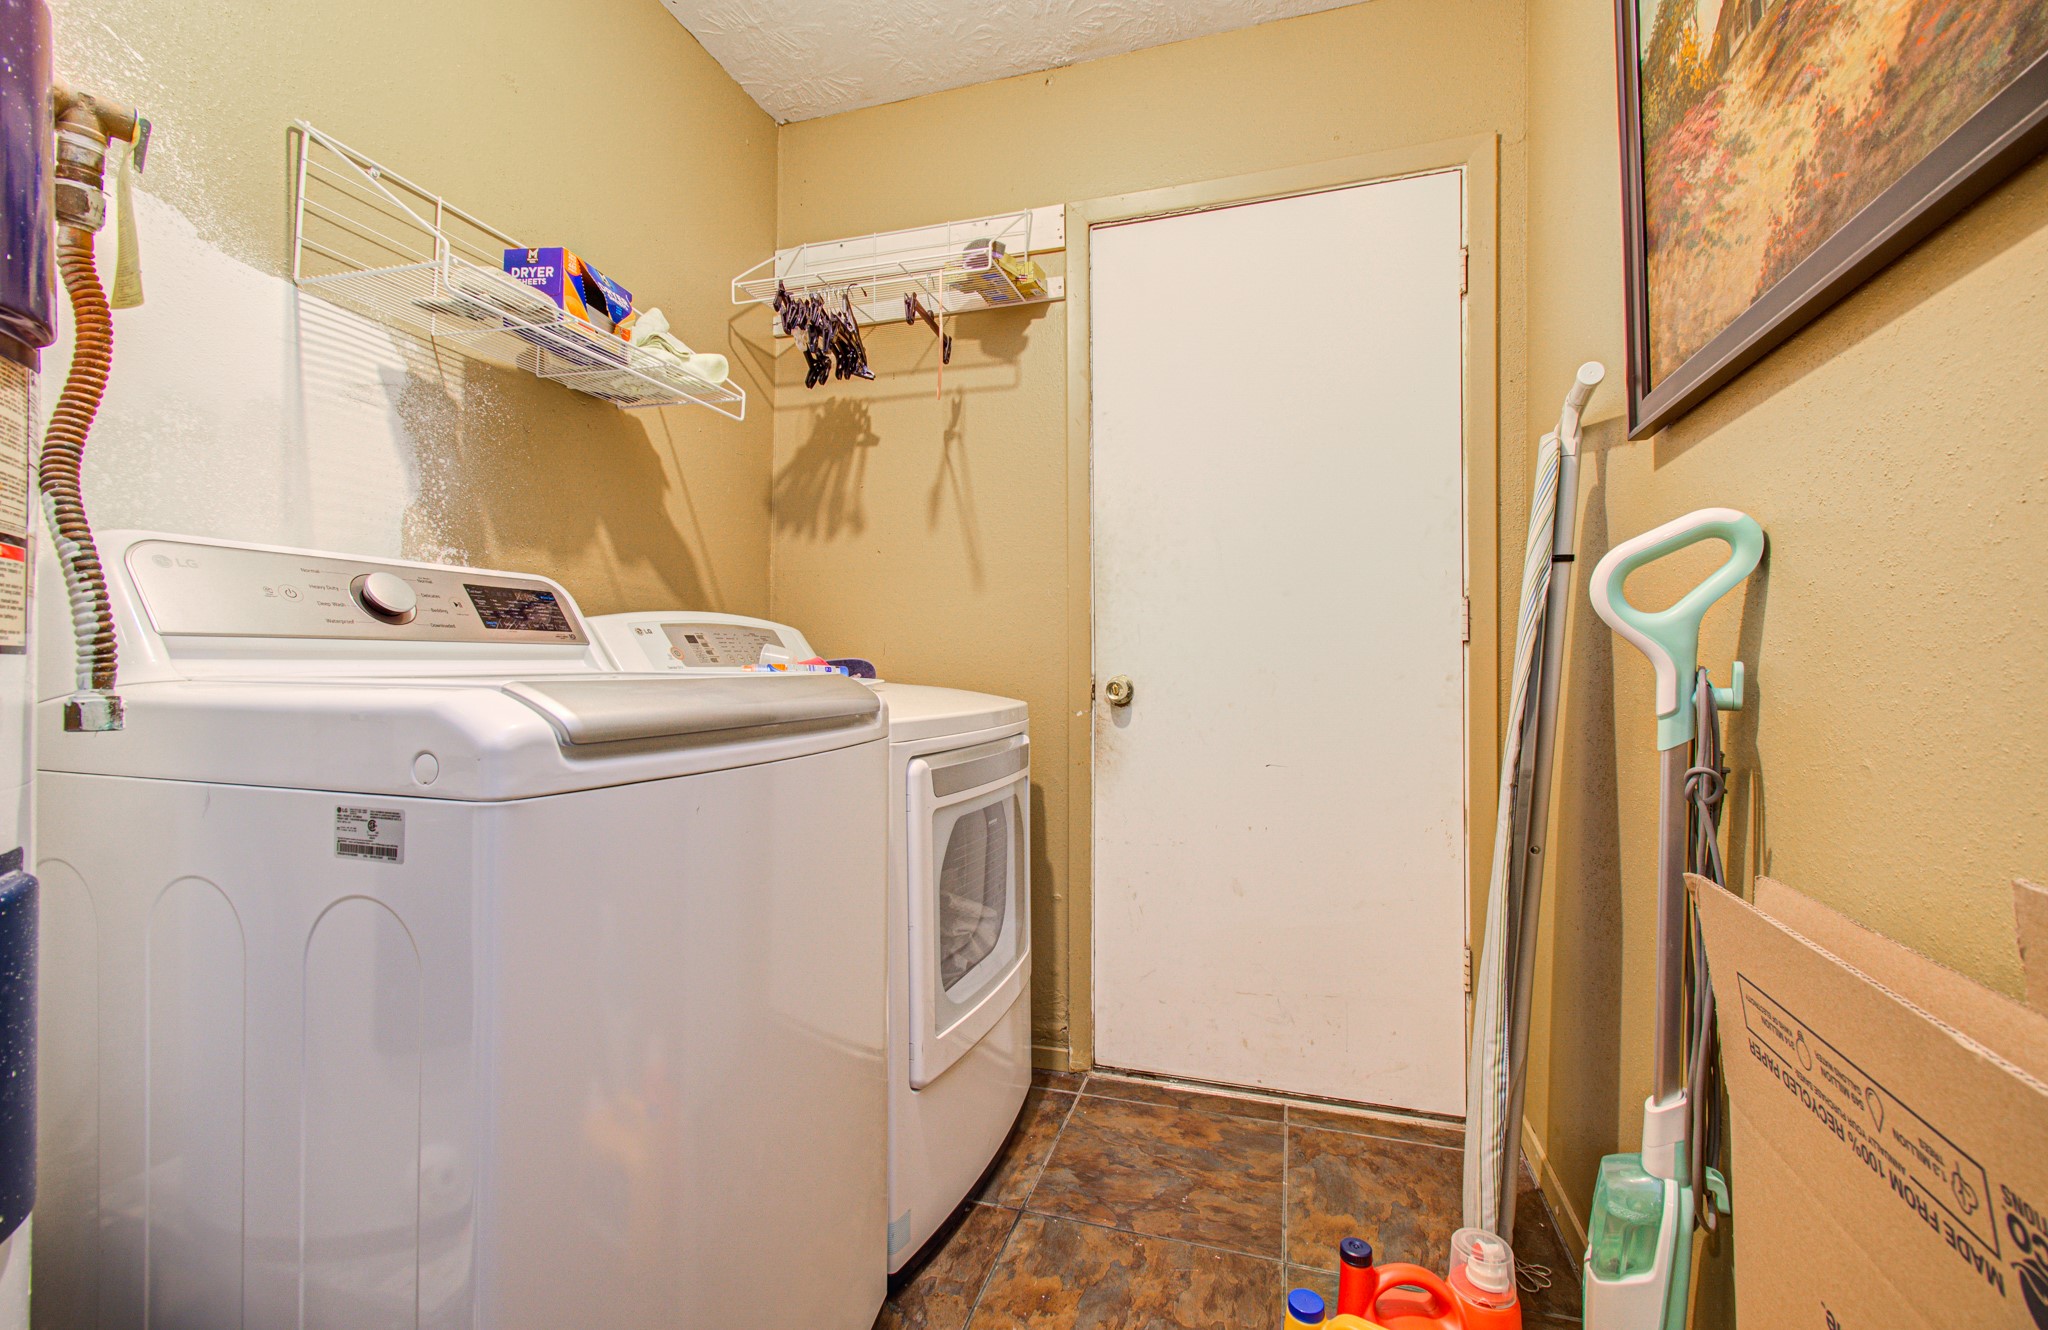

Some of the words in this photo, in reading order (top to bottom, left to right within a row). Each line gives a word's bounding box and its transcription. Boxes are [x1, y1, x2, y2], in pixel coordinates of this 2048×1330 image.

[511, 266, 554, 278] DRYER
[176, 558, 199, 569] LG
[1745, 994, 1772, 1019] ELECTRICITY
[1761, 1015, 1784, 1041] MILLION
[1748, 1037, 1781, 1080] PAPER
[1820, 1065, 1850, 1099] MILLION
[1833, 1066, 1862, 1096] GALLONS
[1782, 1070, 1845, 1142] RECYCLED
[1813, 1084, 1847, 1122] PURCHASE
[1847, 1116, 1867, 1140] YOUR
[1847, 1130, 1886, 1179] 100%
[1868, 1135, 1906, 1176] ANNUALLY
[1892, 1127, 1931, 1170] MILLION
[1918, 1137, 1946, 1167] TREES
[1888, 1168, 1941, 1235] FROM
[1943, 1220, 2006, 1298] MADE
